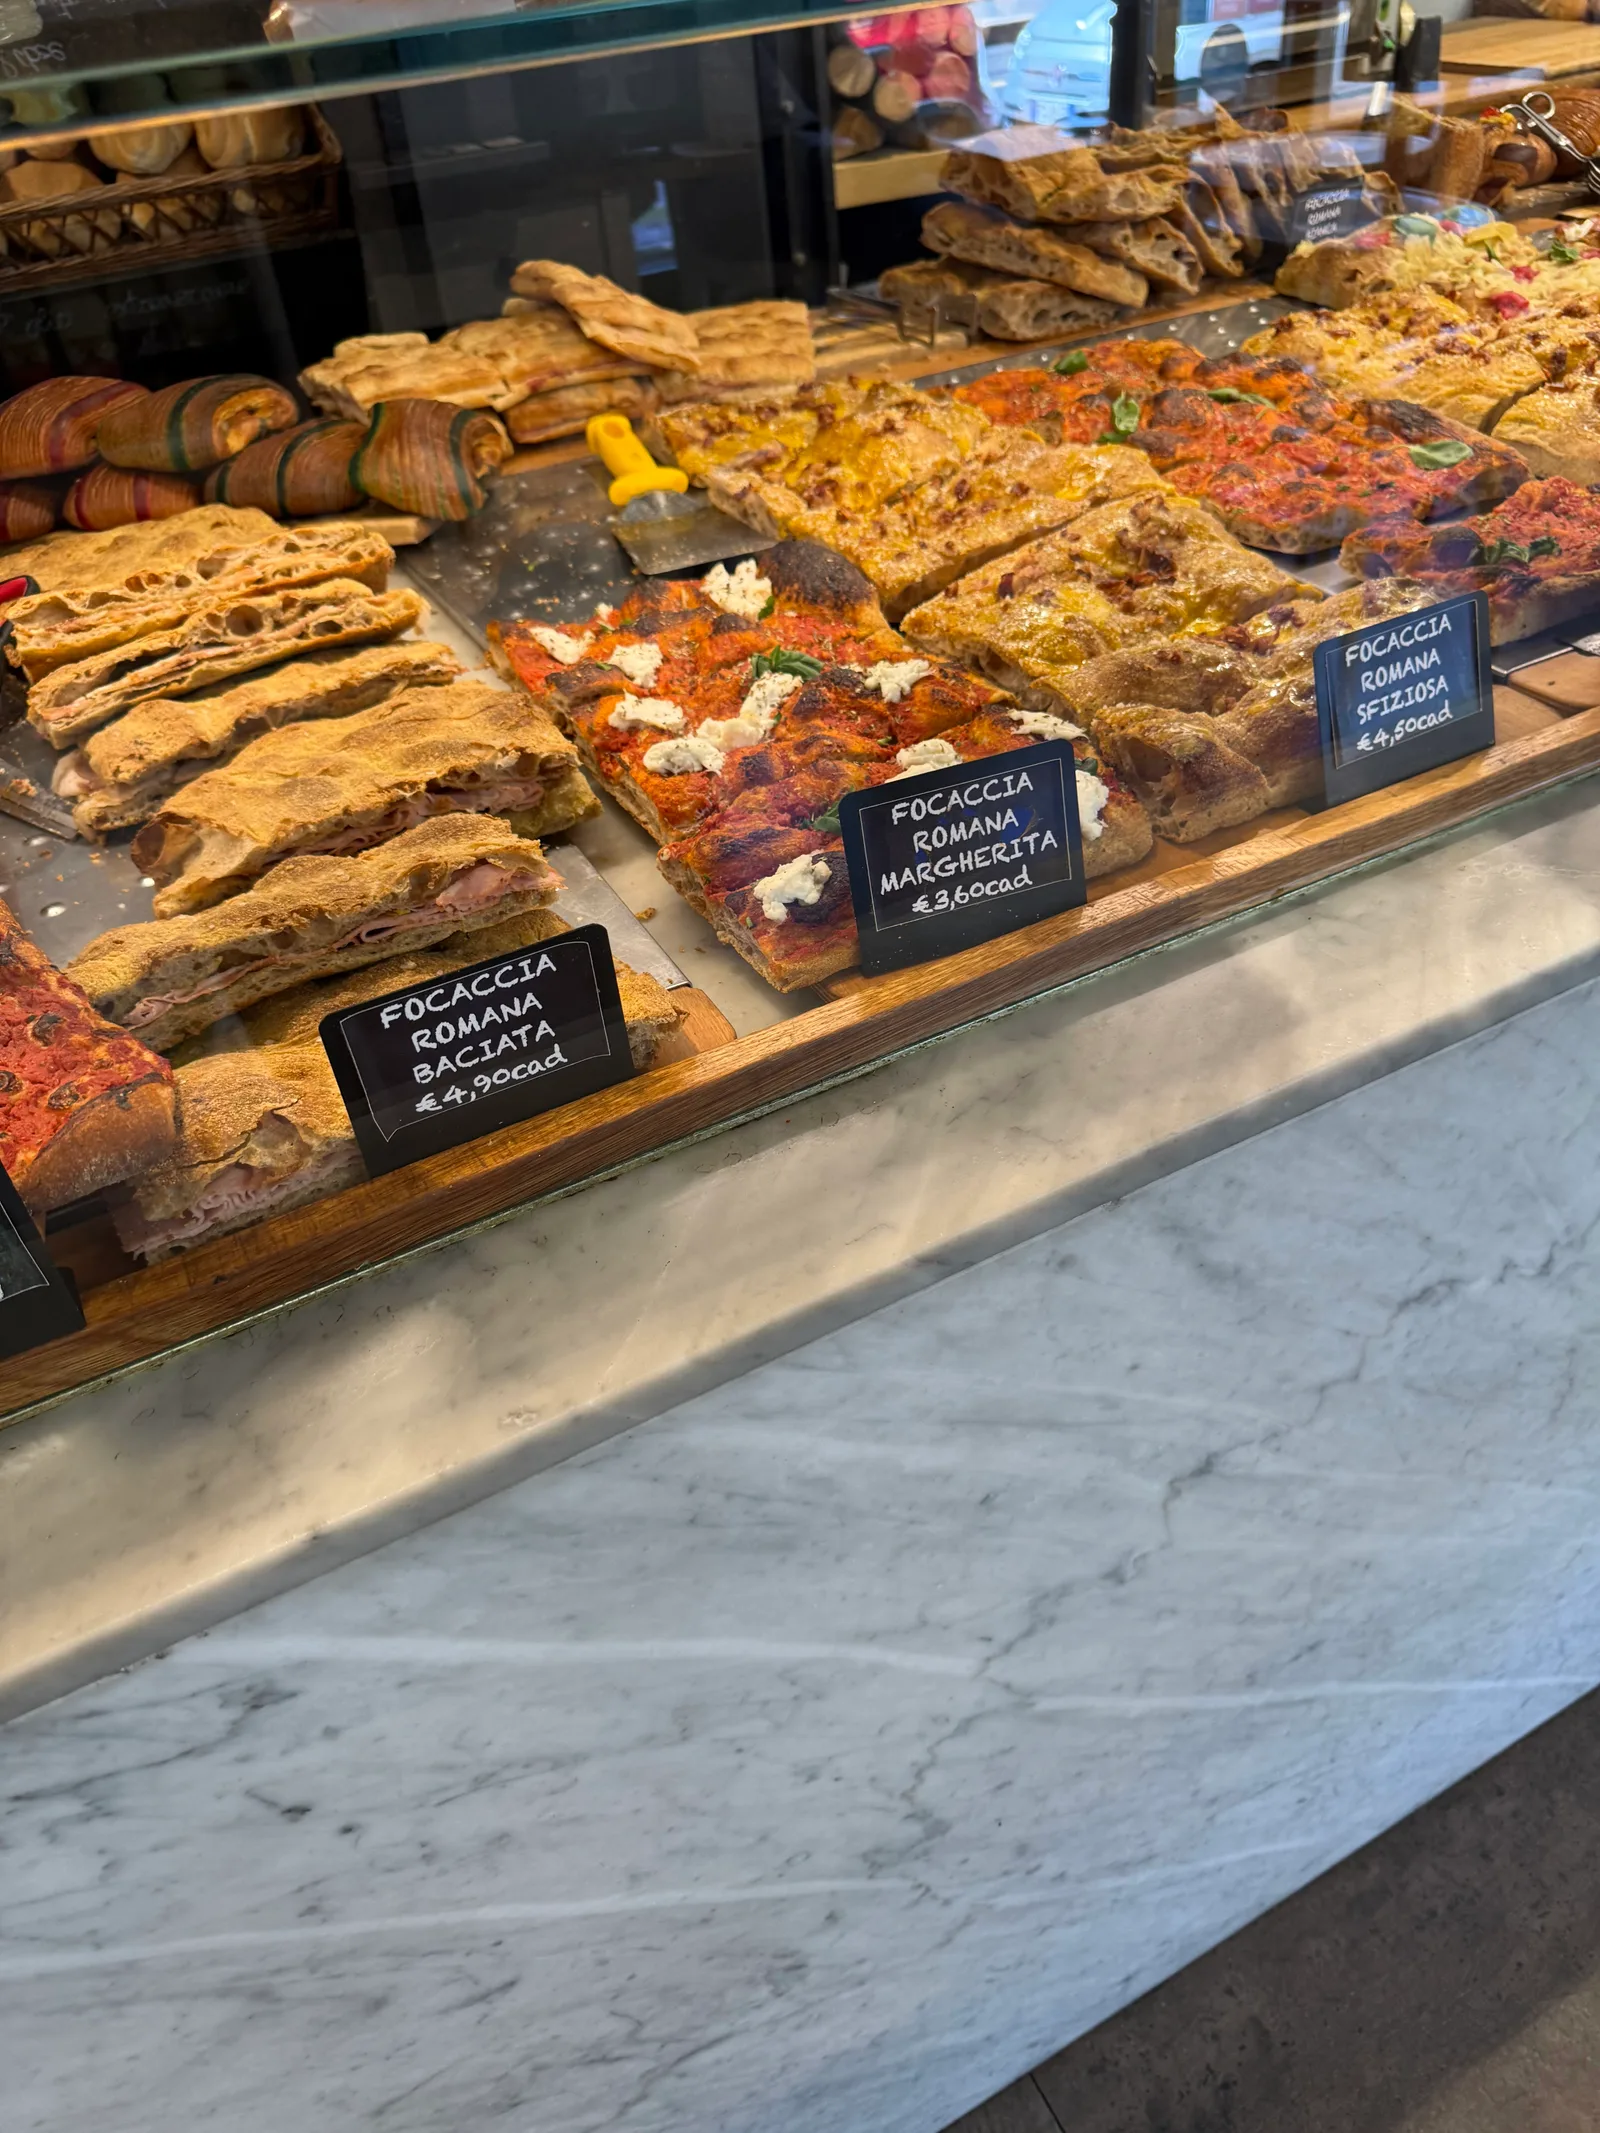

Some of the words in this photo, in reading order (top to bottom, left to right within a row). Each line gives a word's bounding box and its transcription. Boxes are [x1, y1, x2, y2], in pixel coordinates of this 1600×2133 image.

[1345, 613, 1452, 667] FOCACCIA
[1360, 648, 1441, 693] ROMANA
[1356, 675, 1449, 725] SFIZIOSA
[891, 771, 1034, 825] FOCACCIA
[912, 808, 1019, 853] ROMANA
[880, 830, 1058, 895] MARGHERITA
[380, 953, 557, 1029] FOCACCIA
[411, 992, 543, 1053] ROMANA
[412, 1020, 555, 1084] BACIATA
